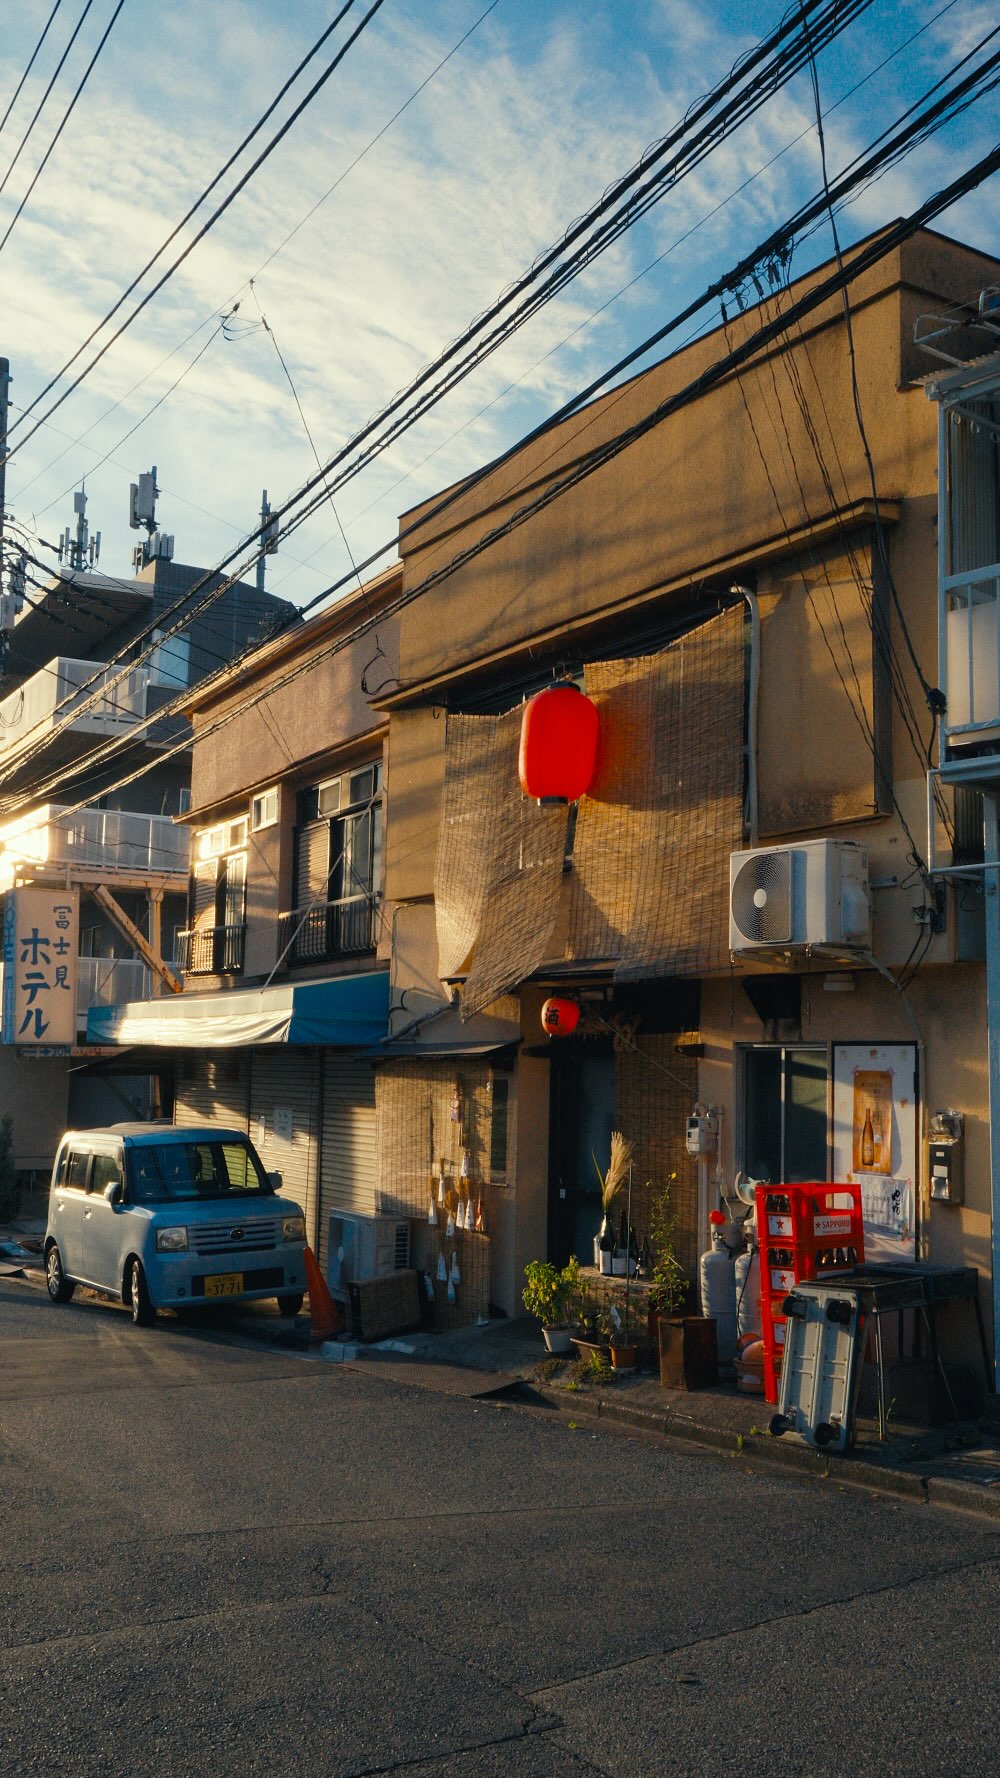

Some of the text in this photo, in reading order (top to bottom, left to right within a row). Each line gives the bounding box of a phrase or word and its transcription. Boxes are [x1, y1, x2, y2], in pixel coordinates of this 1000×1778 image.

[18, 928, 51, 1039] ホテル
[821, 1219, 849, 1229] SAPPORO
[213, 1281, 240, 1295] 37-71
